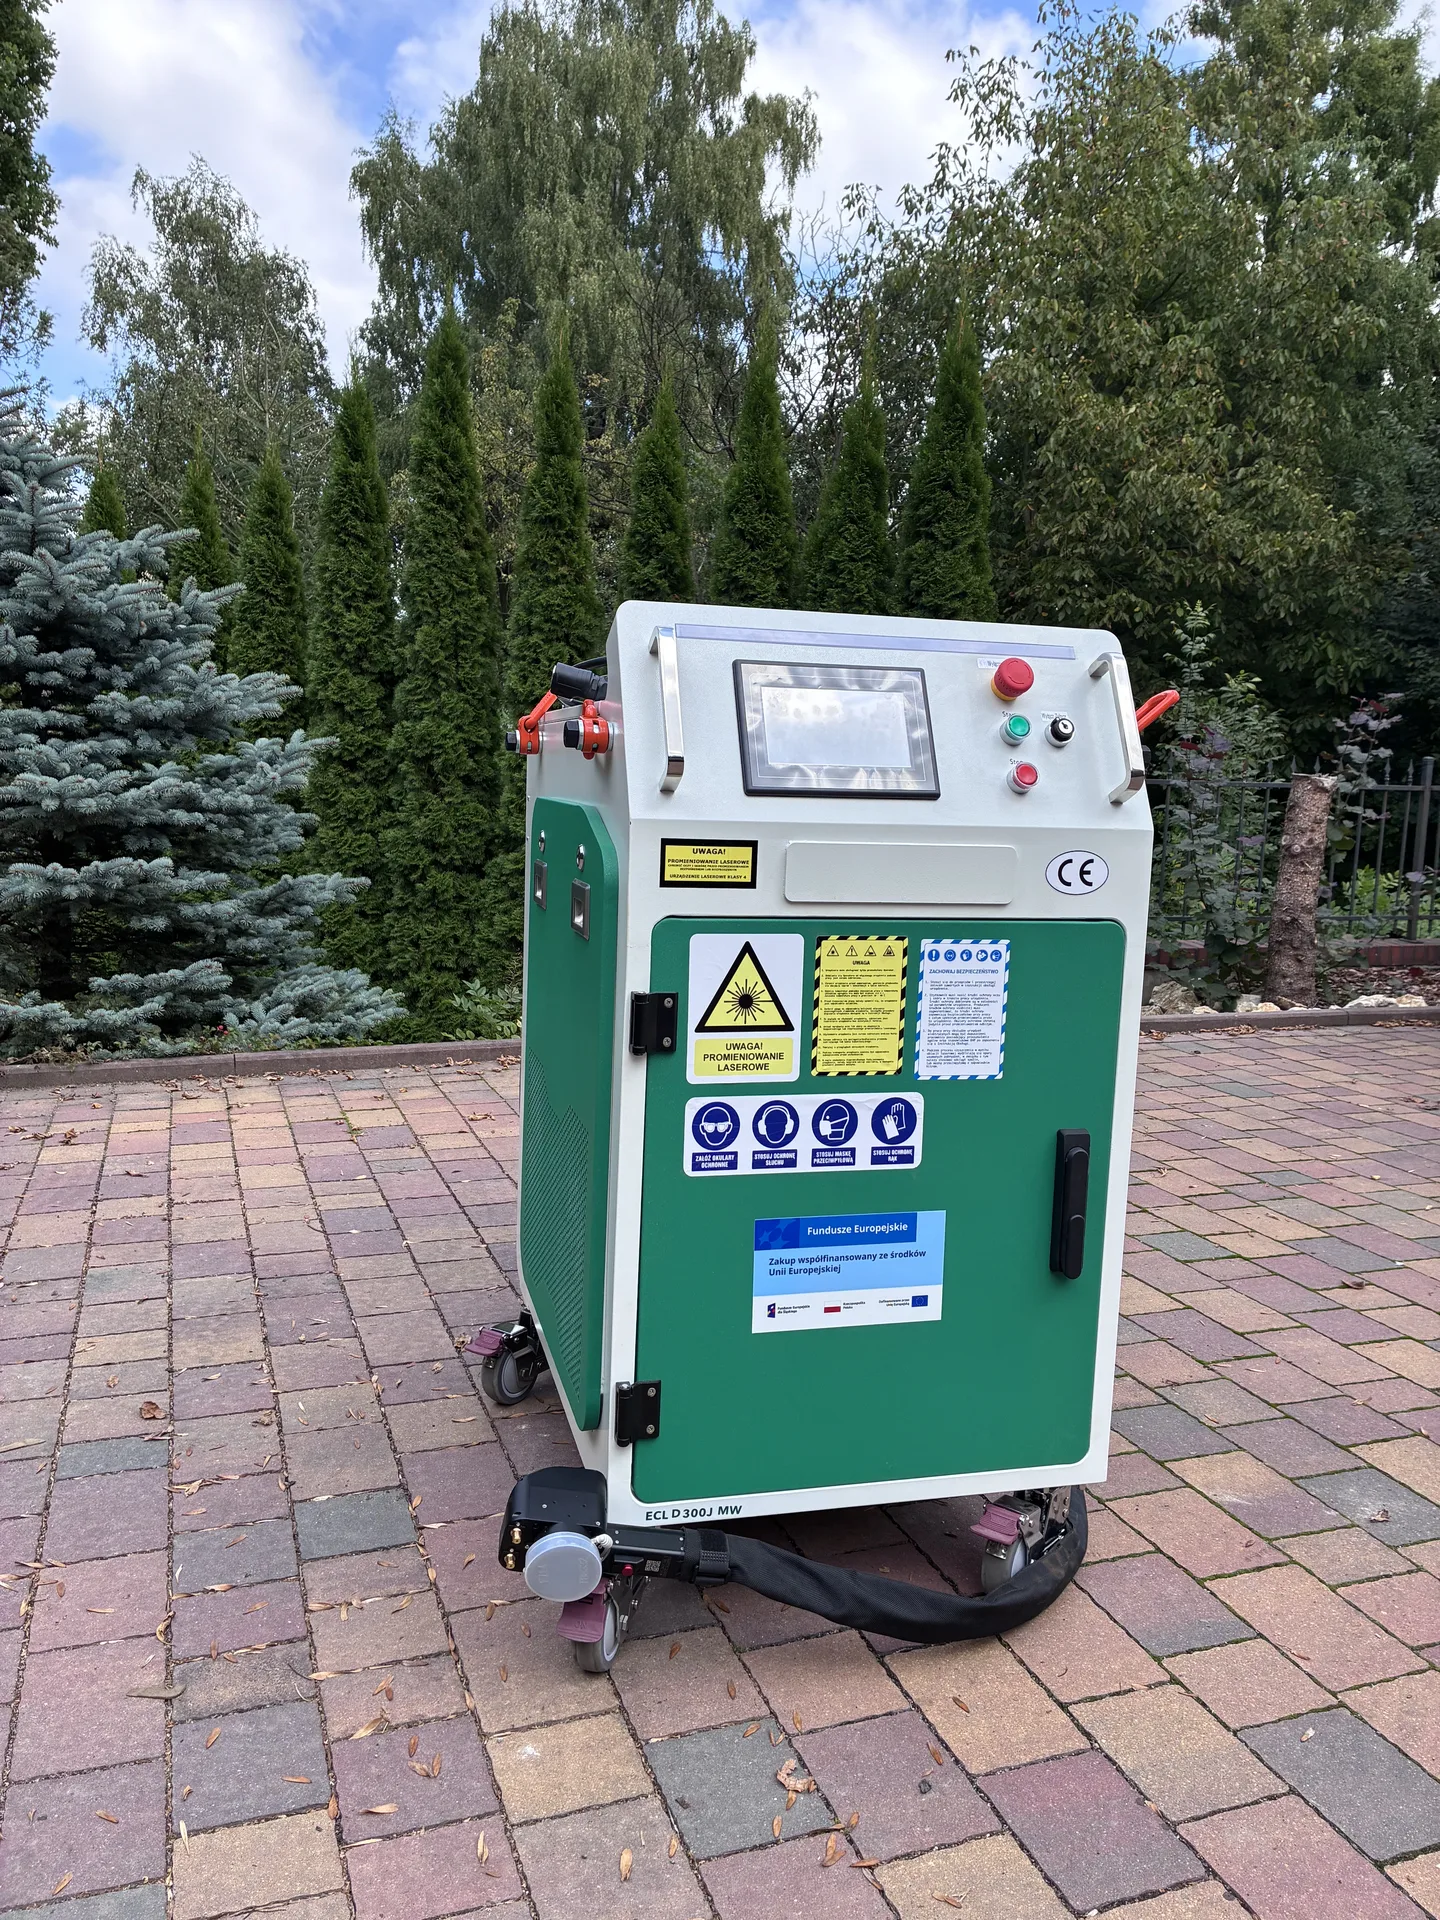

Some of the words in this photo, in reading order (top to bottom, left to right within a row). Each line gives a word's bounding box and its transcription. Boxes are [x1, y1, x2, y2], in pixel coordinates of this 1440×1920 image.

[1058, 858, 1094, 887] CE
[725, 1042, 763, 1050] UWAGA!
[703, 1052, 784, 1062] PROMIENIOWANIE
[717, 1063, 770, 1072] LASEROWE
[807, 1226, 852, 1236] Fundusze
[854, 1222, 908, 1234] Europejskie
[769, 1257, 796, 1266] Zakup
[798, 1252, 877, 1264] współfinansowany
[890, 1249, 926, 1259] środków
[769, 1268, 786, 1276] Unii
[789, 1264, 841, 1275] Europejskiej
[646, 1510, 668, 1520] ECL
[672, 1509, 680, 1518] D
[682, 1507, 713, 1518] 300J
[718, 1505, 742, 1515] MW
